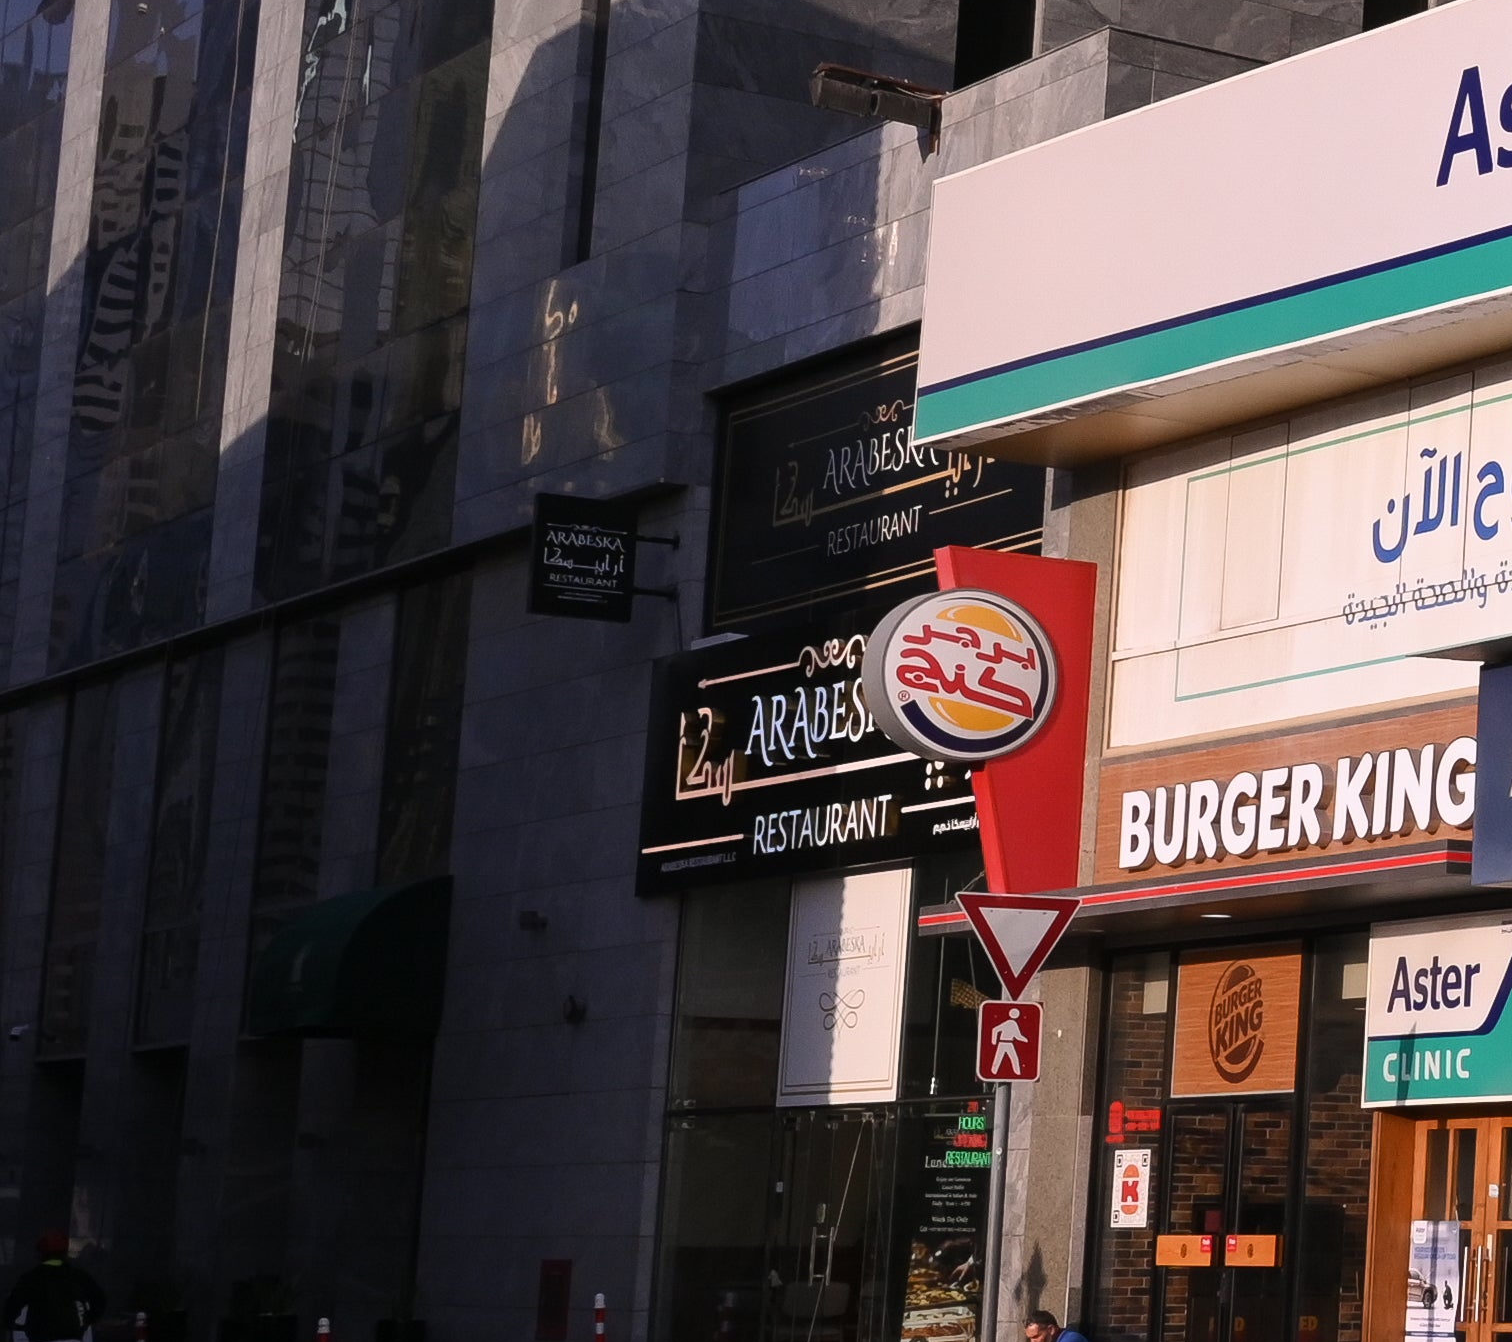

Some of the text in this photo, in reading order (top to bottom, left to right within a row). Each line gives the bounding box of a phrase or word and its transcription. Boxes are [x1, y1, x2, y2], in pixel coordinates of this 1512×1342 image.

[827, 505, 922, 557] RESTAURANT
[1373, 447, 1462, 563] الآن
[546, 529, 627, 554] ARABESKA
[549, 573, 618, 588] RESTAURANT
[903, 625, 1036, 671] برجر
[753, 794, 892, 855] RESTAURANT
[1119, 737, 1477, 869] BURGER KING
[1214, 977, 1263, 1027] BURGER
[1387, 956, 1481, 1013] Aster
[1215, 1000, 1264, 1057] KING
[1383, 1049, 1471, 1082] CLINIC
